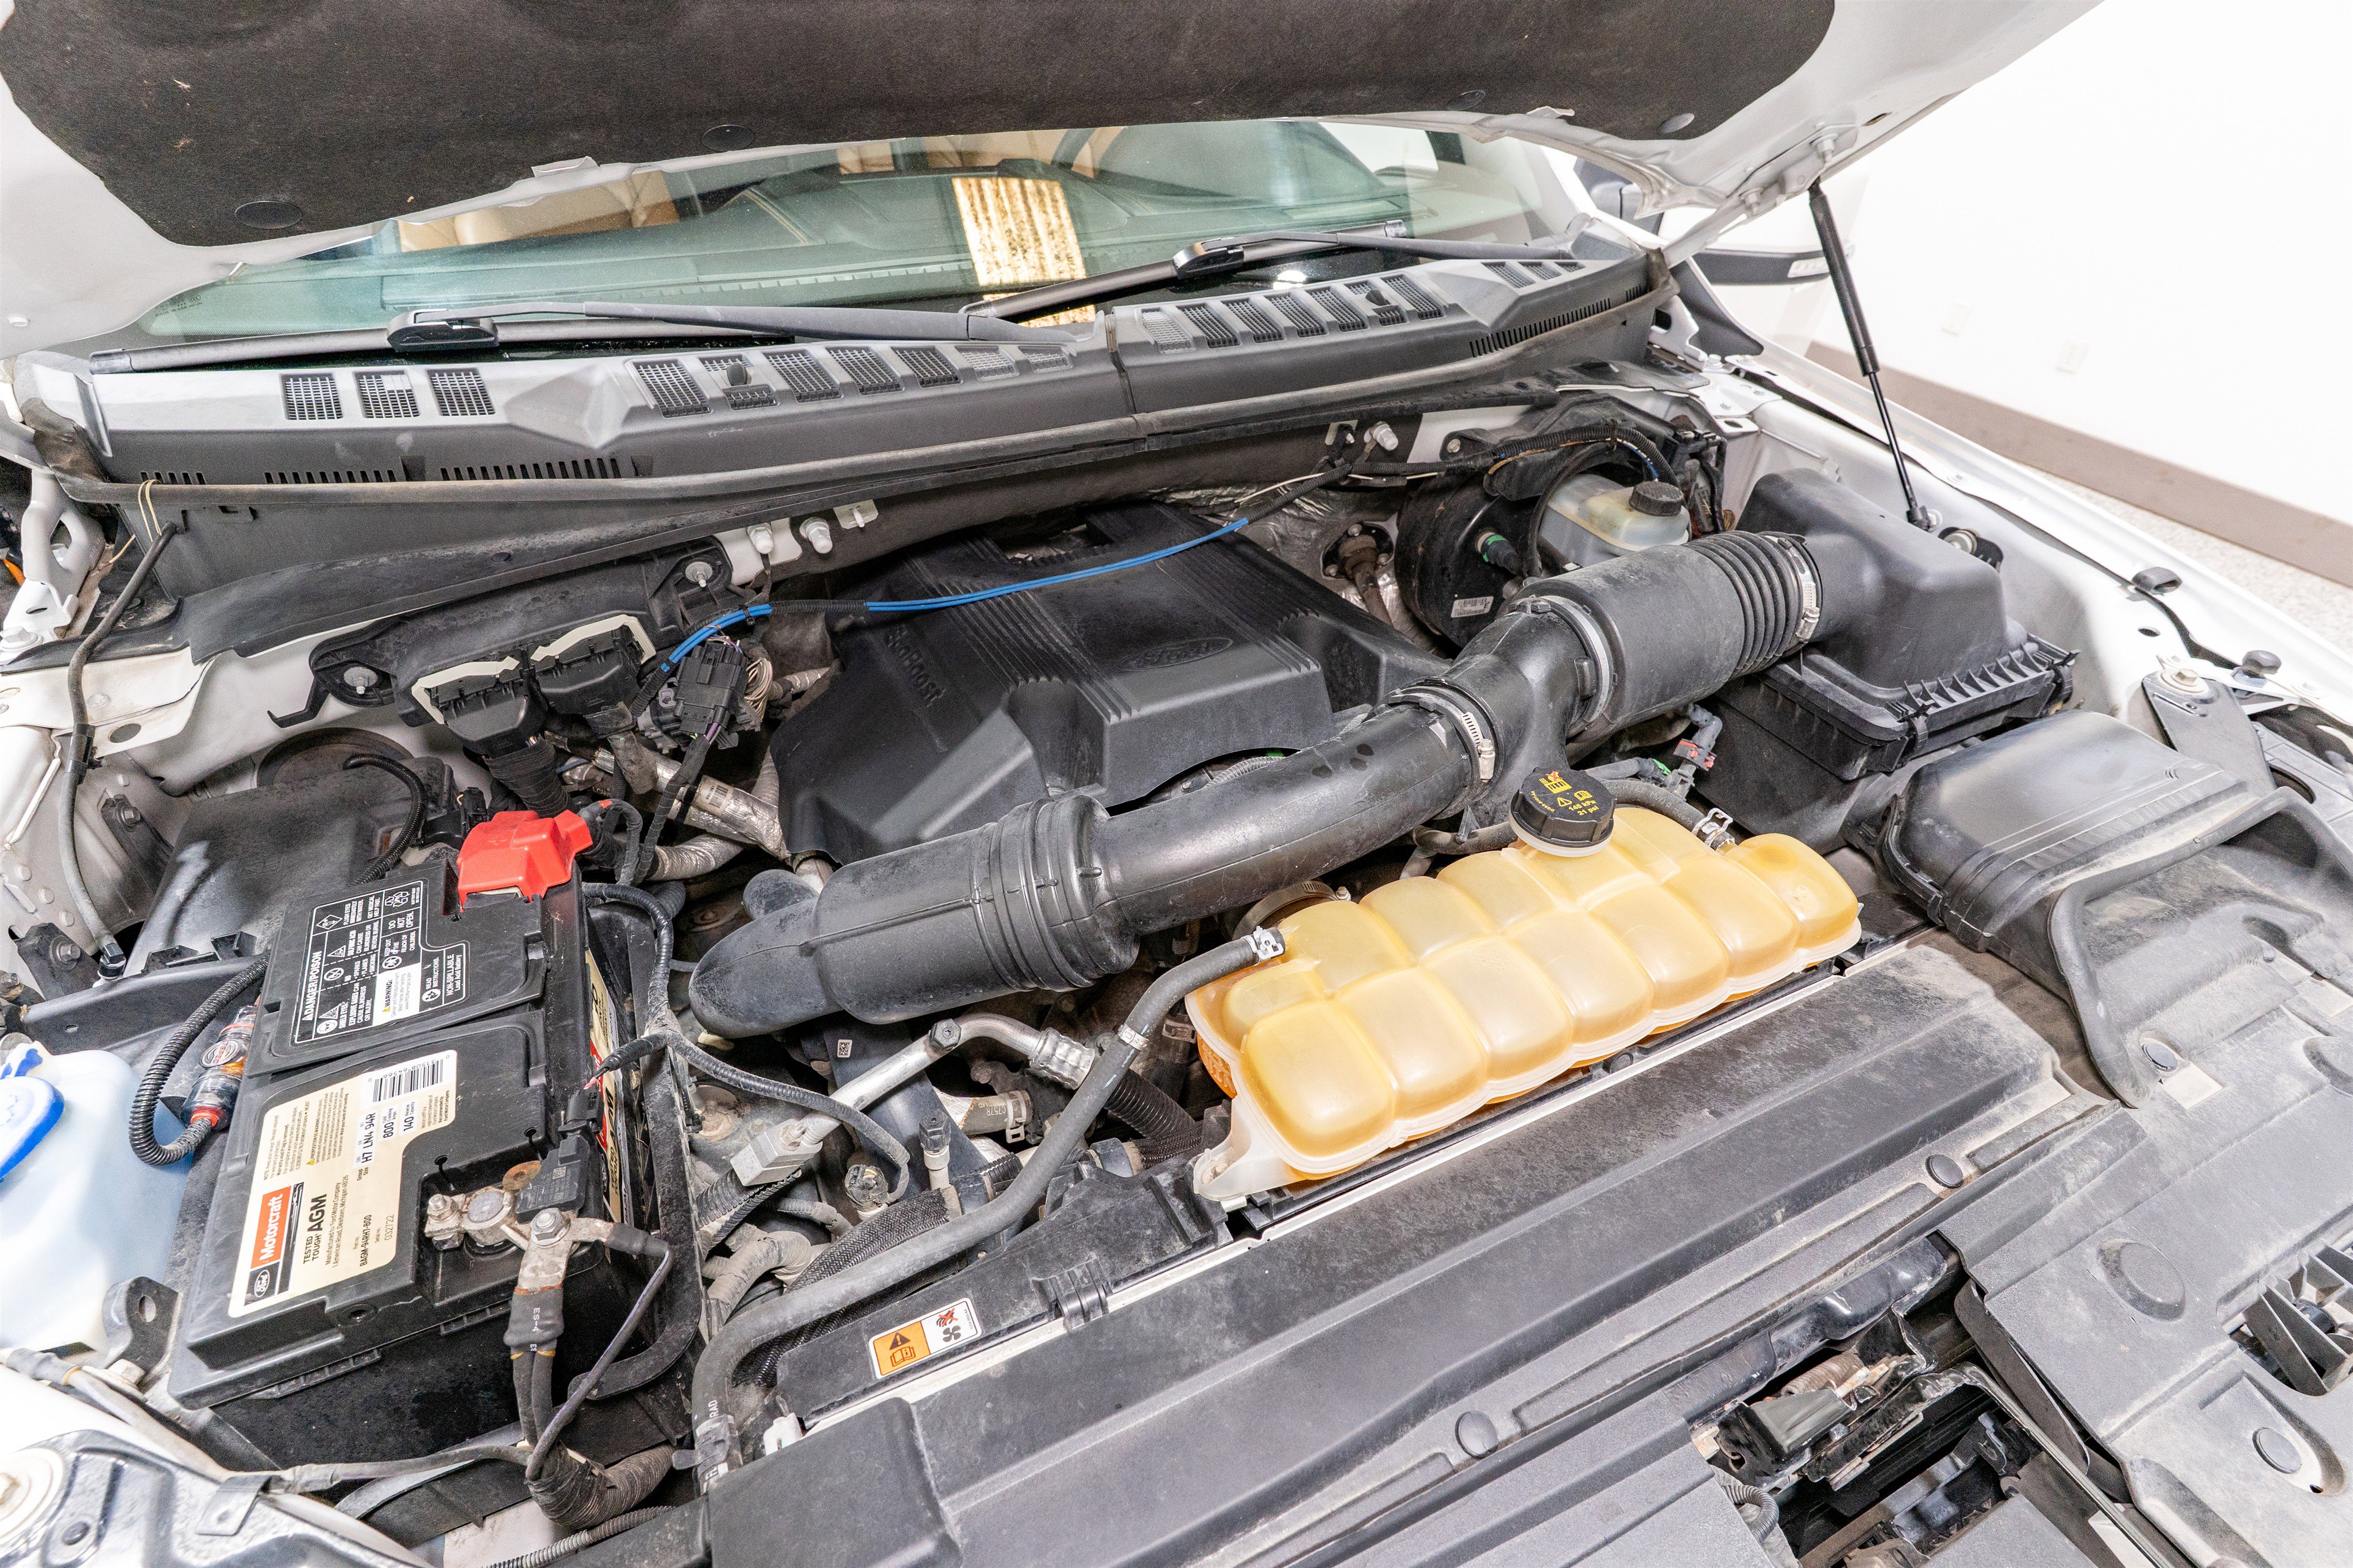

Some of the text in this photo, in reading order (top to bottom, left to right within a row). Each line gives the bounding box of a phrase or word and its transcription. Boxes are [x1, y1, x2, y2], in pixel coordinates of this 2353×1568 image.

[1587, 805, 1599, 813] psi
[388, 920, 396, 929] DO
[397, 917, 405, 928] NOT
[406, 911, 414, 928] OPEN.
[304, 951, 322, 1015] DANGER/POISON
[446, 954, 454, 996] NON-SPILLABLE
[384, 980, 392, 1007] WARNING:
[349, 1004, 357, 1026] EXPLOSIVE
[986, 1106, 1006, 1116] C757R
[383, 1122, 394, 1138] 800
[403, 1117, 414, 1131] 140
[361, 1113, 375, 1163] H7 LN4 94R
[340, 1188, 348, 1207] Michigan
[259, 1194, 283, 1261] Motorcraft
[303, 1194, 326, 1264] TESTED AGM
[325, 1232, 334, 1265] Manufactured
[333, 1183, 341, 1202] Company
[337, 1207, 345, 1229] Dearborn,
[384, 1214, 394, 1241] 032722
[335, 1229, 343, 1242] Road,
[360, 1215, 371, 1266] BAGM-94RH7-800
[333, 1242, 341, 1264] American
[254, 1272, 269, 1294] Ford
[532, 1307, 541, 1332] ES-4
